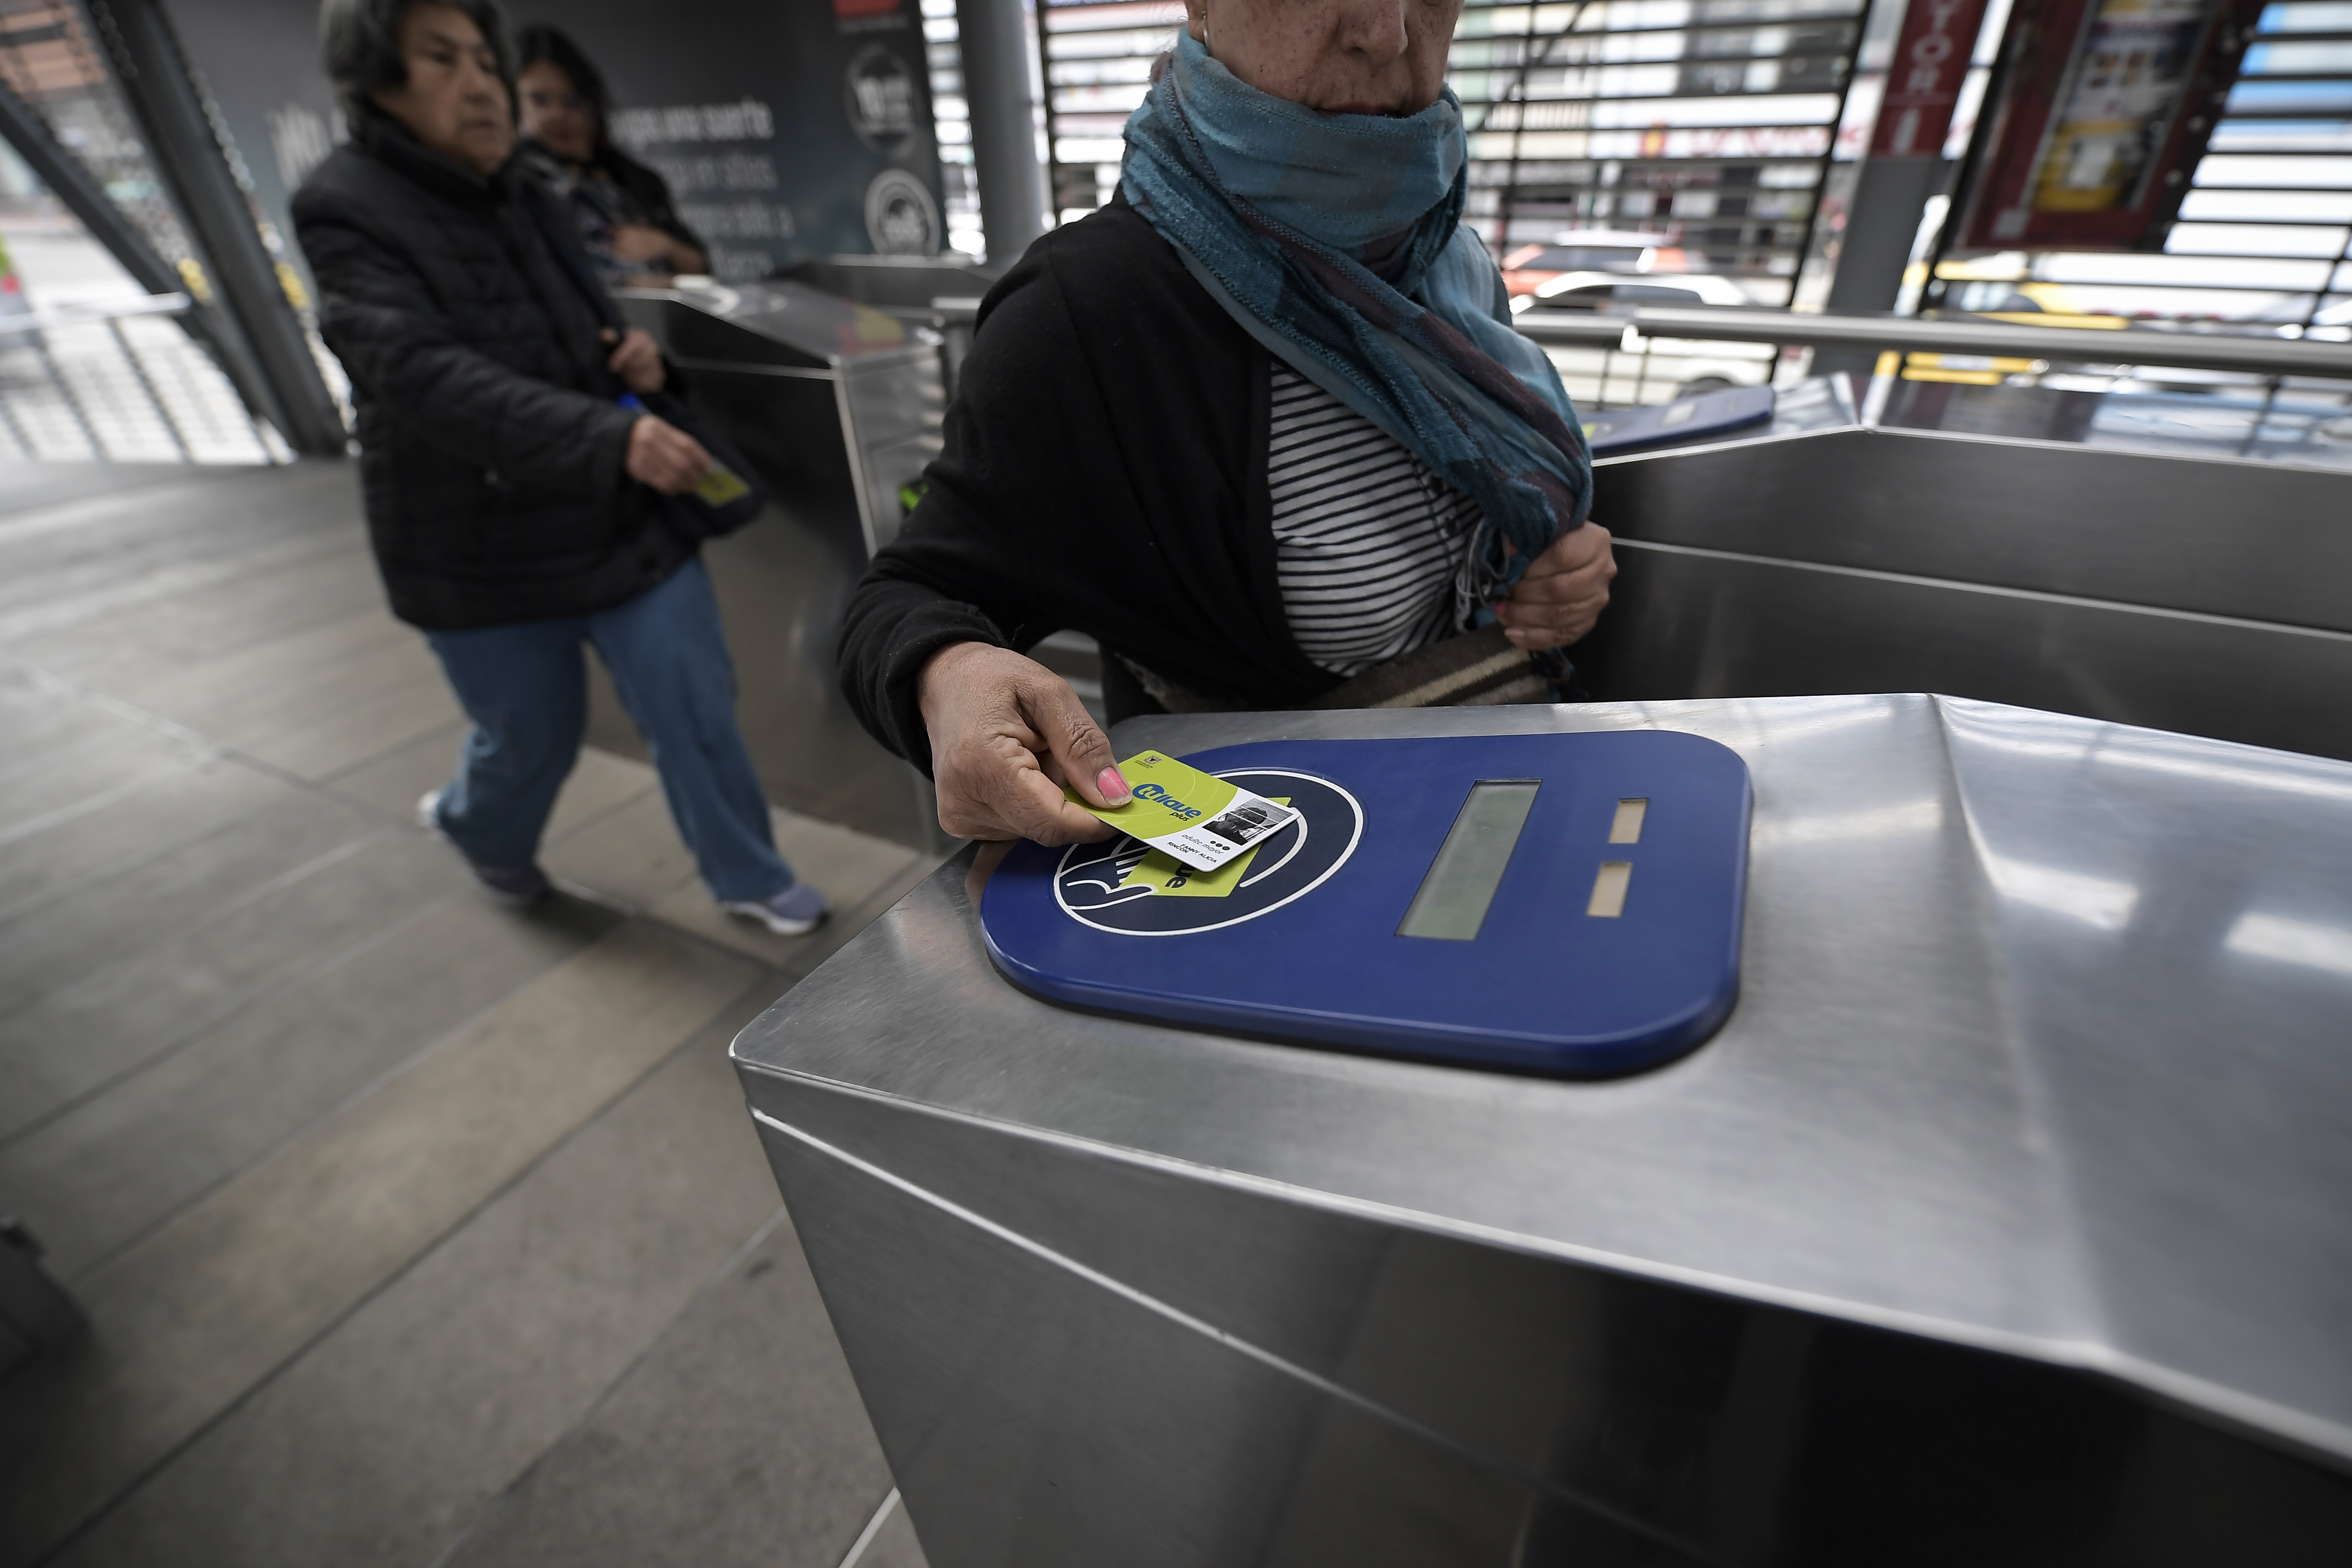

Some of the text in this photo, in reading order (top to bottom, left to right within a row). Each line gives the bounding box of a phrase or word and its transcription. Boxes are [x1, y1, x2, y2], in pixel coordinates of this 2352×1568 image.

[1169, 812, 1190, 822] plus
[1180, 844, 1217, 863] FANNY ALICIA
[1181, 834, 1224, 854] adulto mayor
